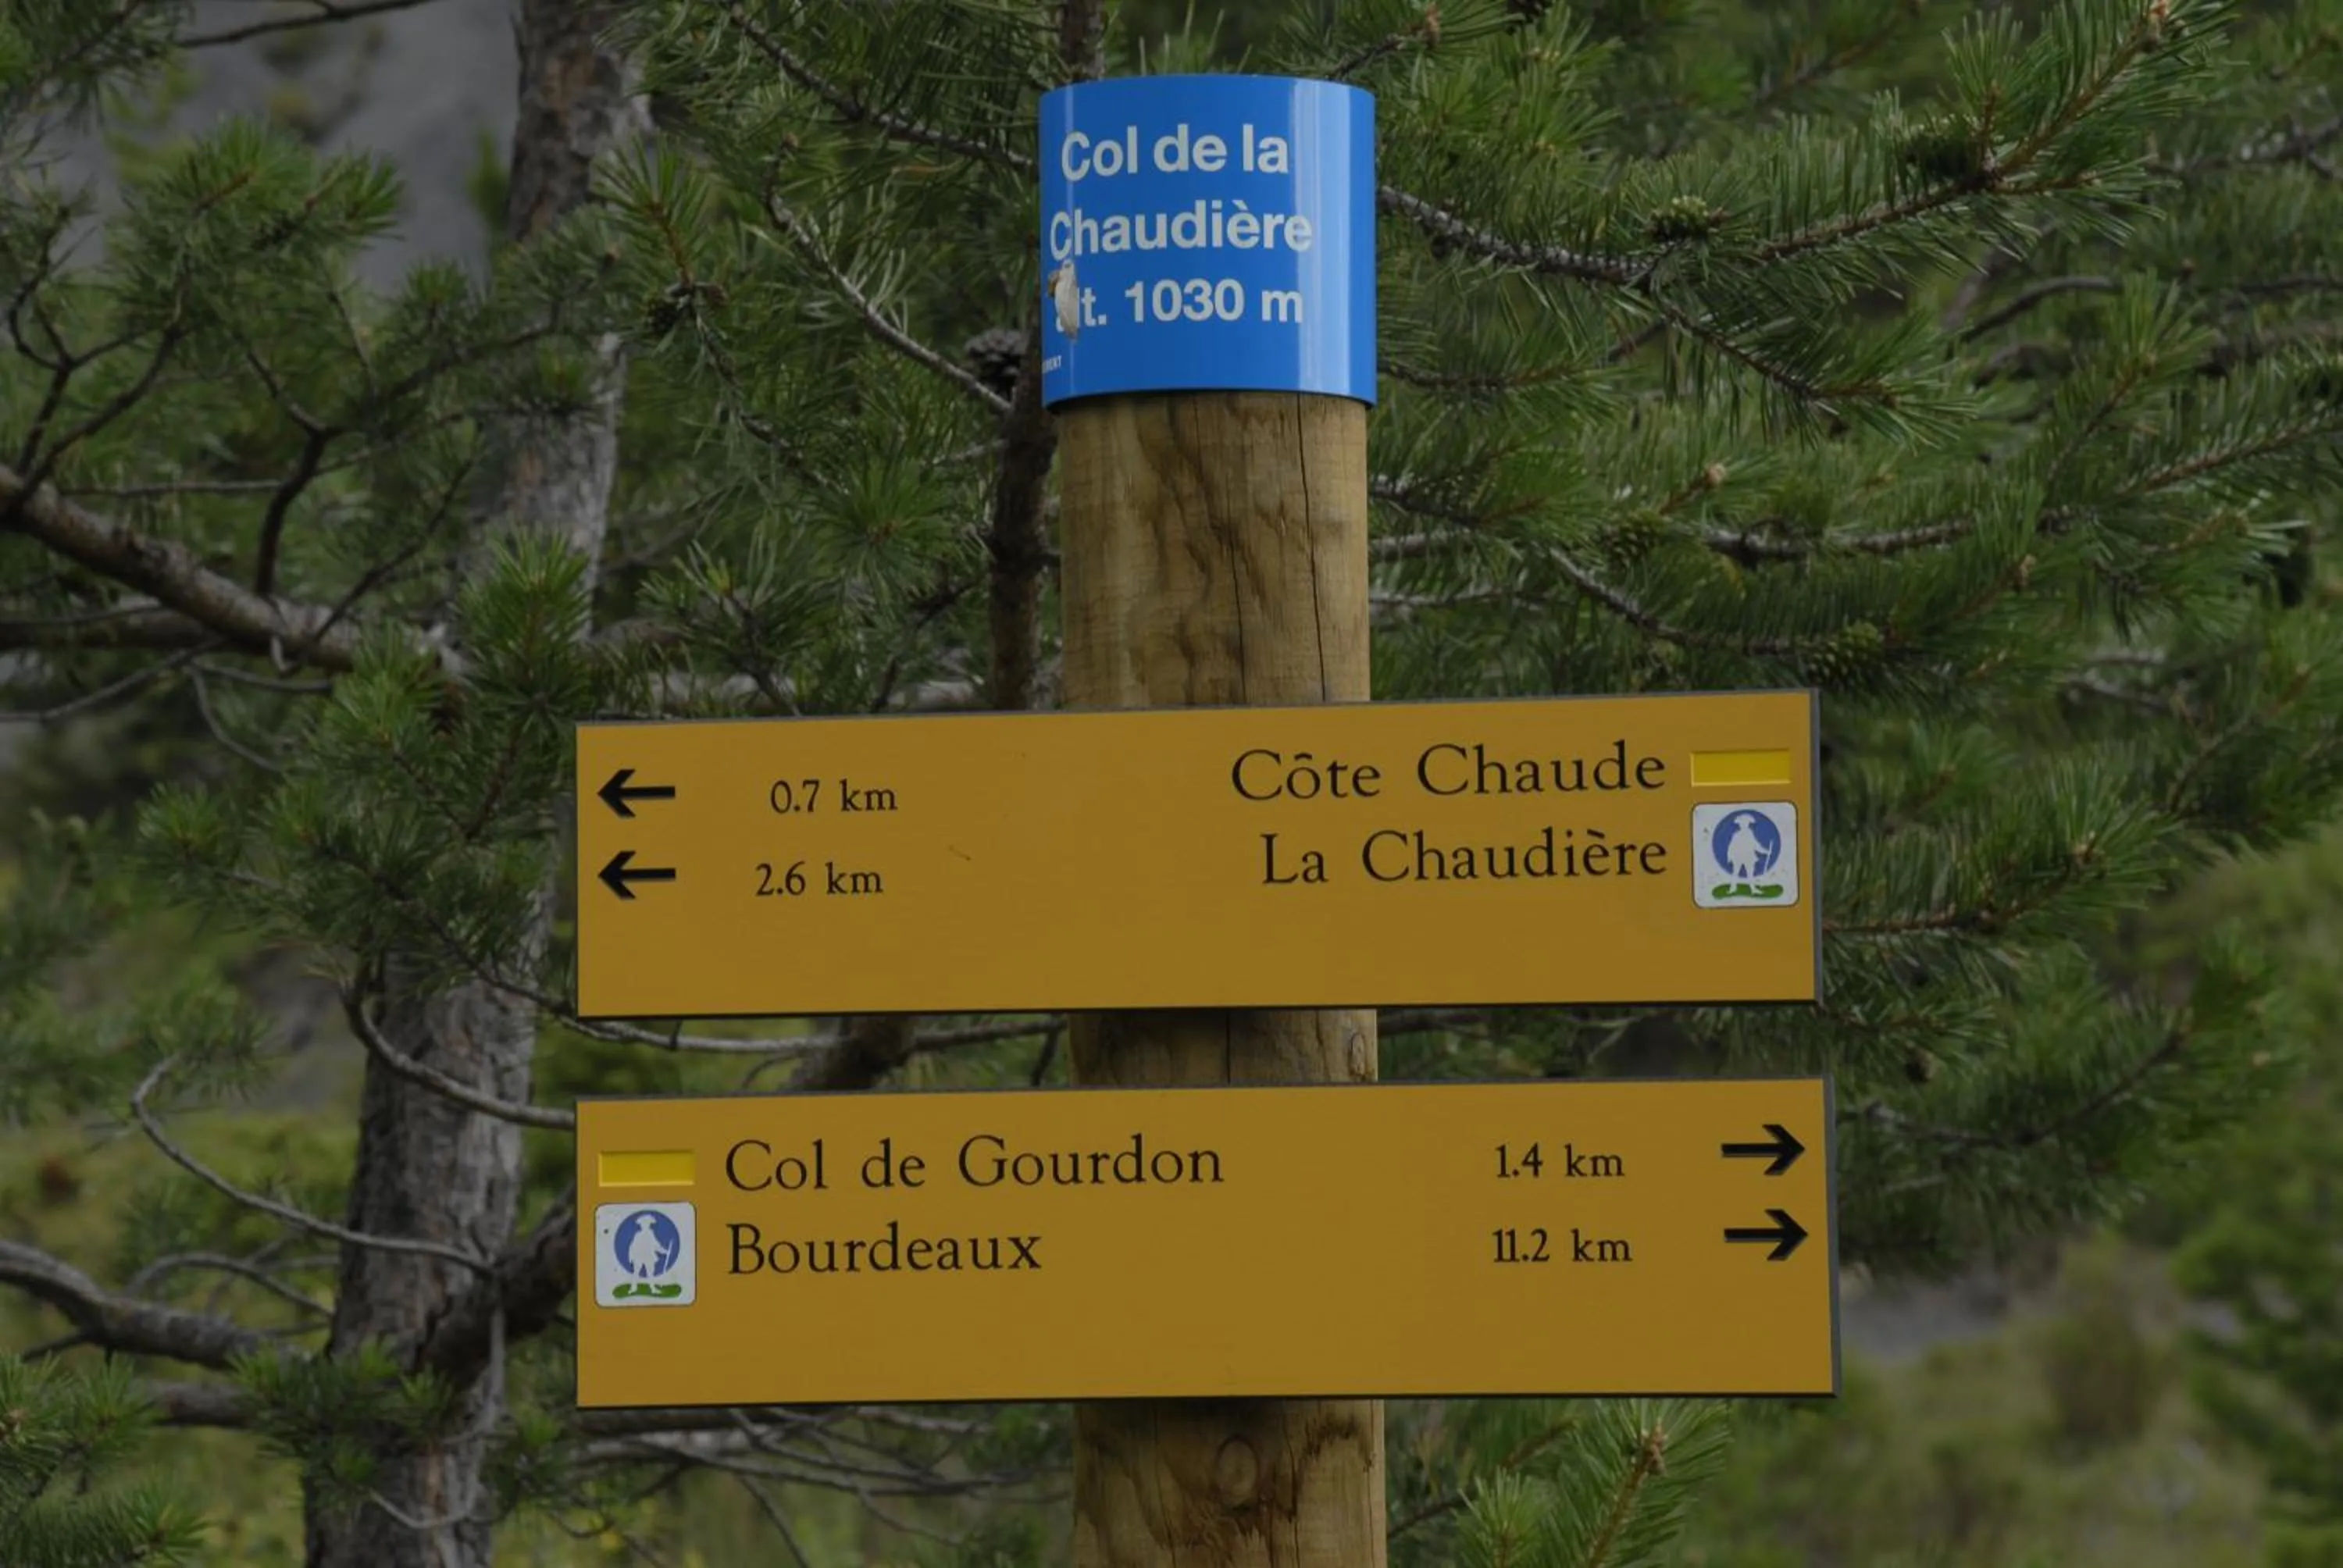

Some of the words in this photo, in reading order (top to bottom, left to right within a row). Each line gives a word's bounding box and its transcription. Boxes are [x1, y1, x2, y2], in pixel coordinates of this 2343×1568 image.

[1061, 125, 1138, 180] Col
[1154, 124, 1227, 172] de
[1243, 124, 1289, 173] la
[1050, 199, 1312, 260] Chaudière
[1055, 286, 1107, 333] t.
[1125, 279, 1244, 323] 1030
[1261, 289, 1303, 324] m
[771, 779, 821, 814] 0.7
[840, 778, 899, 813] km
[1232, 750, 1382, 802] Côte
[1418, 739, 1667, 796] Chaude
[755, 861, 807, 897] 2.6
[825, 861, 884, 896] km
[1261, 833, 1329, 886] La
[1362, 826, 1668, 883] Chaudière
[726, 1139, 829, 1192] Col
[861, 1138, 927, 1189] de
[958, 1133, 1225, 1188] Gourdon
[1496, 1143, 1544, 1179] 1.4
[1564, 1143, 1626, 1178] km
[726, 1221, 1043, 1275] Bourdeaux
[1492, 1228, 1551, 1263] 11.2
[1571, 1228, 1633, 1263] km
